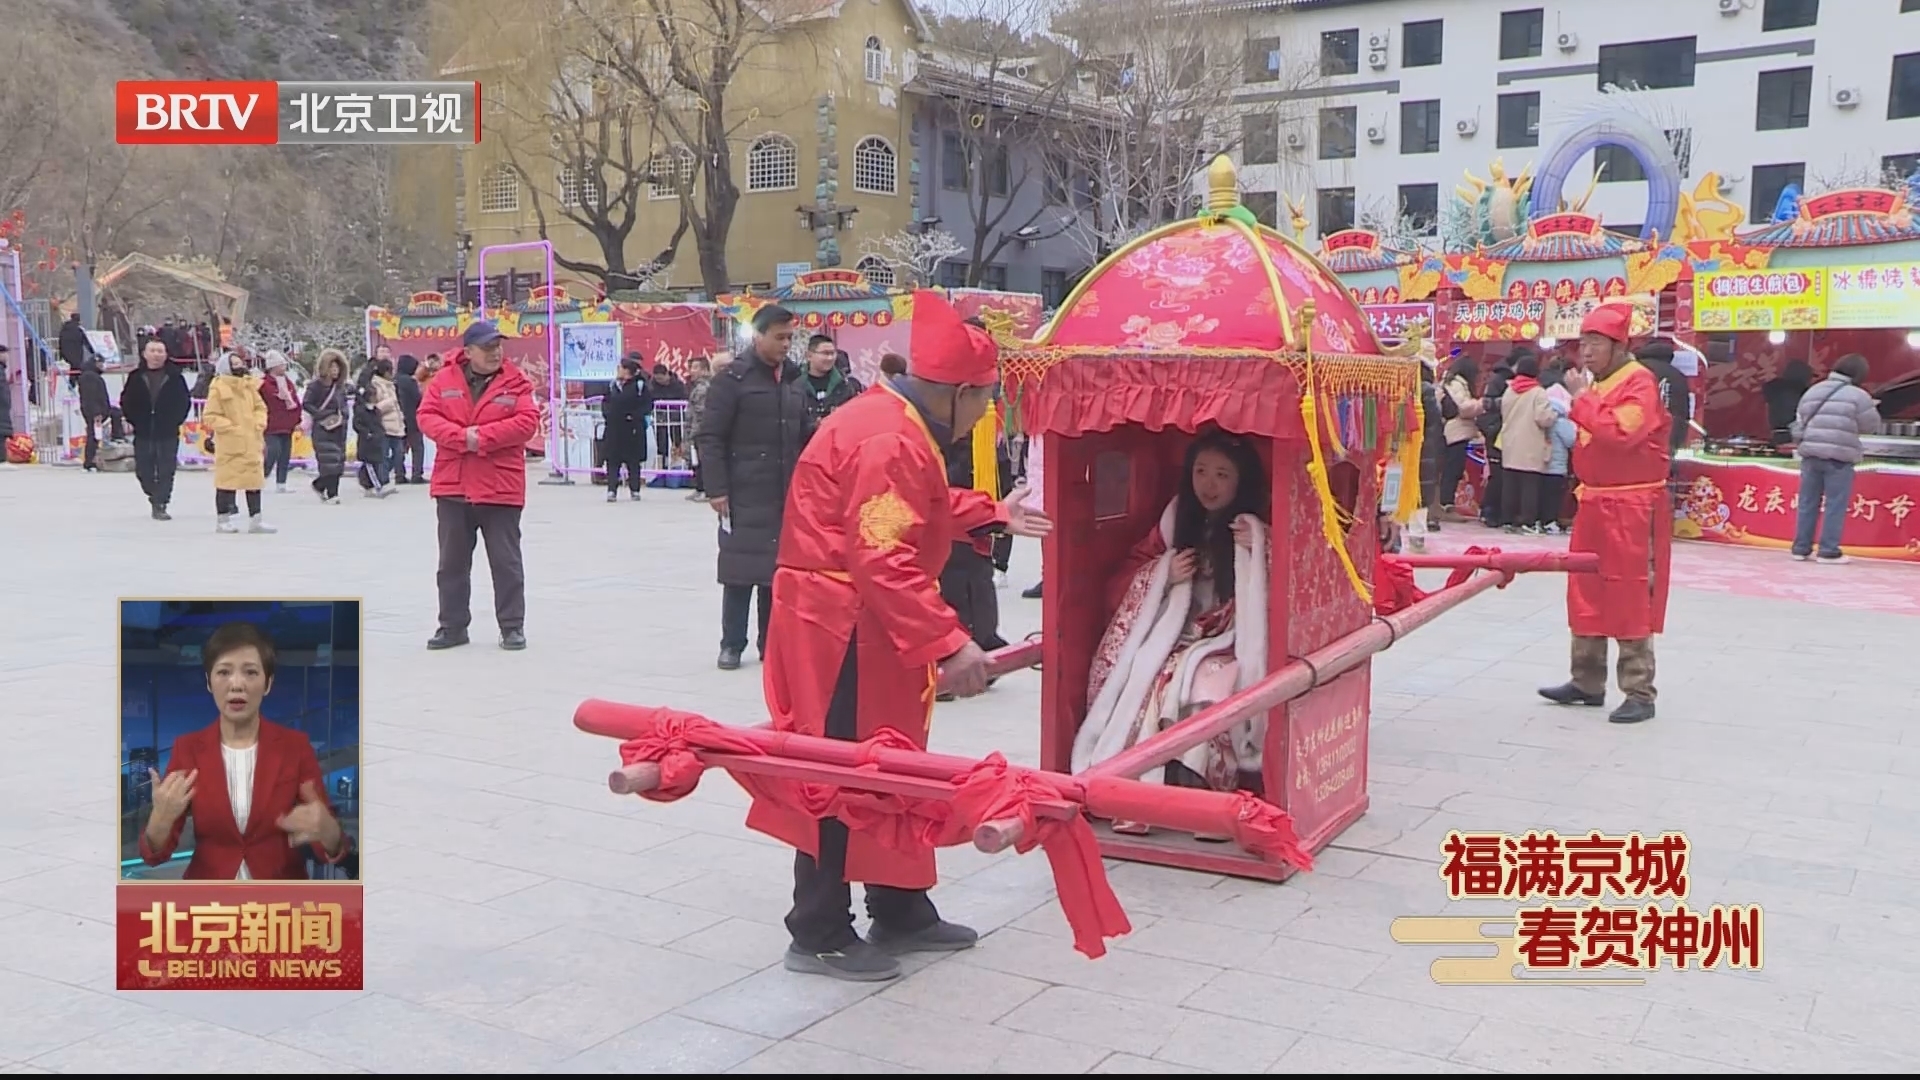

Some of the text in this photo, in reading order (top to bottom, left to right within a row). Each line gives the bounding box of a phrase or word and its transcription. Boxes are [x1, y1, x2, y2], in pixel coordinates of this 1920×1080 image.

[1714, 273, 1802, 296] 拇指生煎包
[1455, 300, 1545, 322] 无骨炸鸡柳
[1737, 484, 1916, 528] 龙庆灯节
